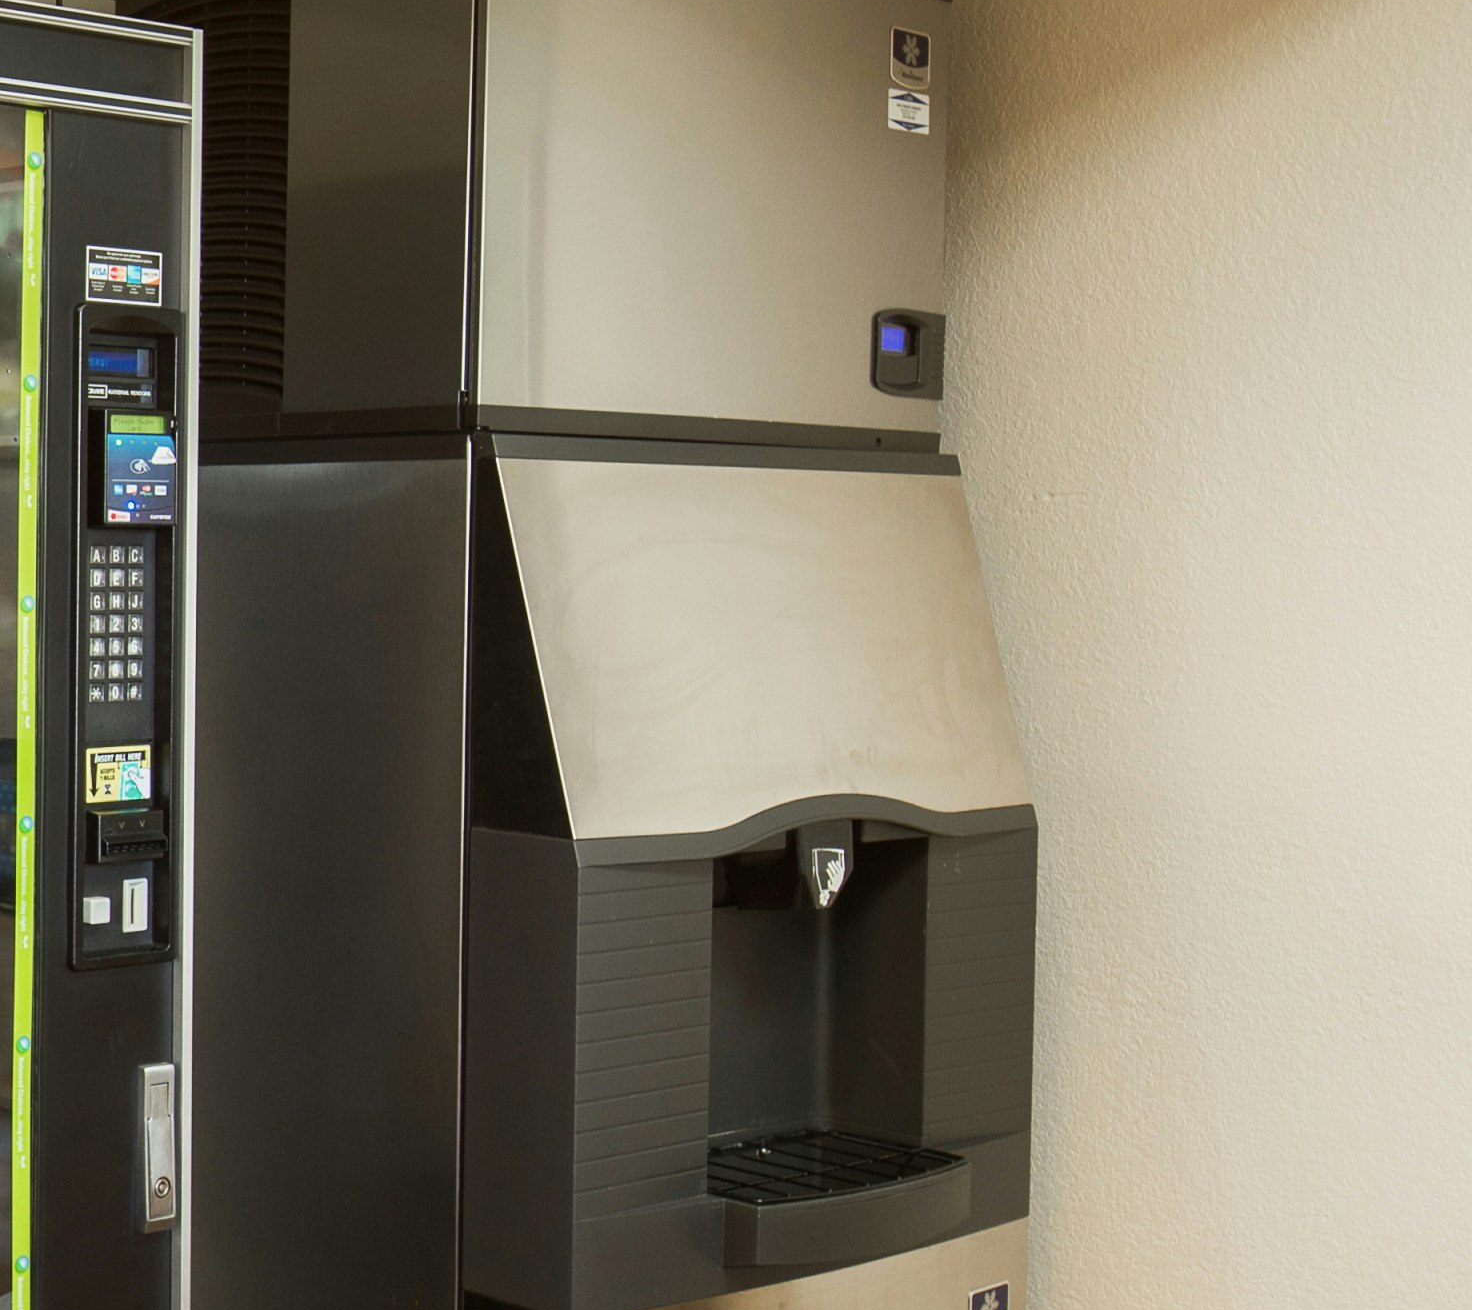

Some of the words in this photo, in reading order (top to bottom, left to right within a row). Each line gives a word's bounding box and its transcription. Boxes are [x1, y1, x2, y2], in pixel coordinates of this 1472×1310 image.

[91, 267, 107, 276] VISA
[93, 548, 101, 563] A
[113, 548, 120, 563] B
[131, 548, 138, 563] C
[93, 571, 101, 586] D
[113, 571, 120, 586] E
[131, 572, 138, 586] F
[93, 594, 101, 609] G
[112, 594, 120, 608] H
[131, 594, 138, 608] J
[94, 618, 100, 632] 1
[113, 618, 120, 632] 2
[131, 617, 138, 631] 3
[93, 640, 100, 654] 4
[113, 640, 119, 654] 5
[131, 639, 138, 653] 6
[93, 664, 100, 678] 7
[113, 663, 119, 677] 8
[131, 662, 138, 676] 9
[112, 686, 119, 700] 0
